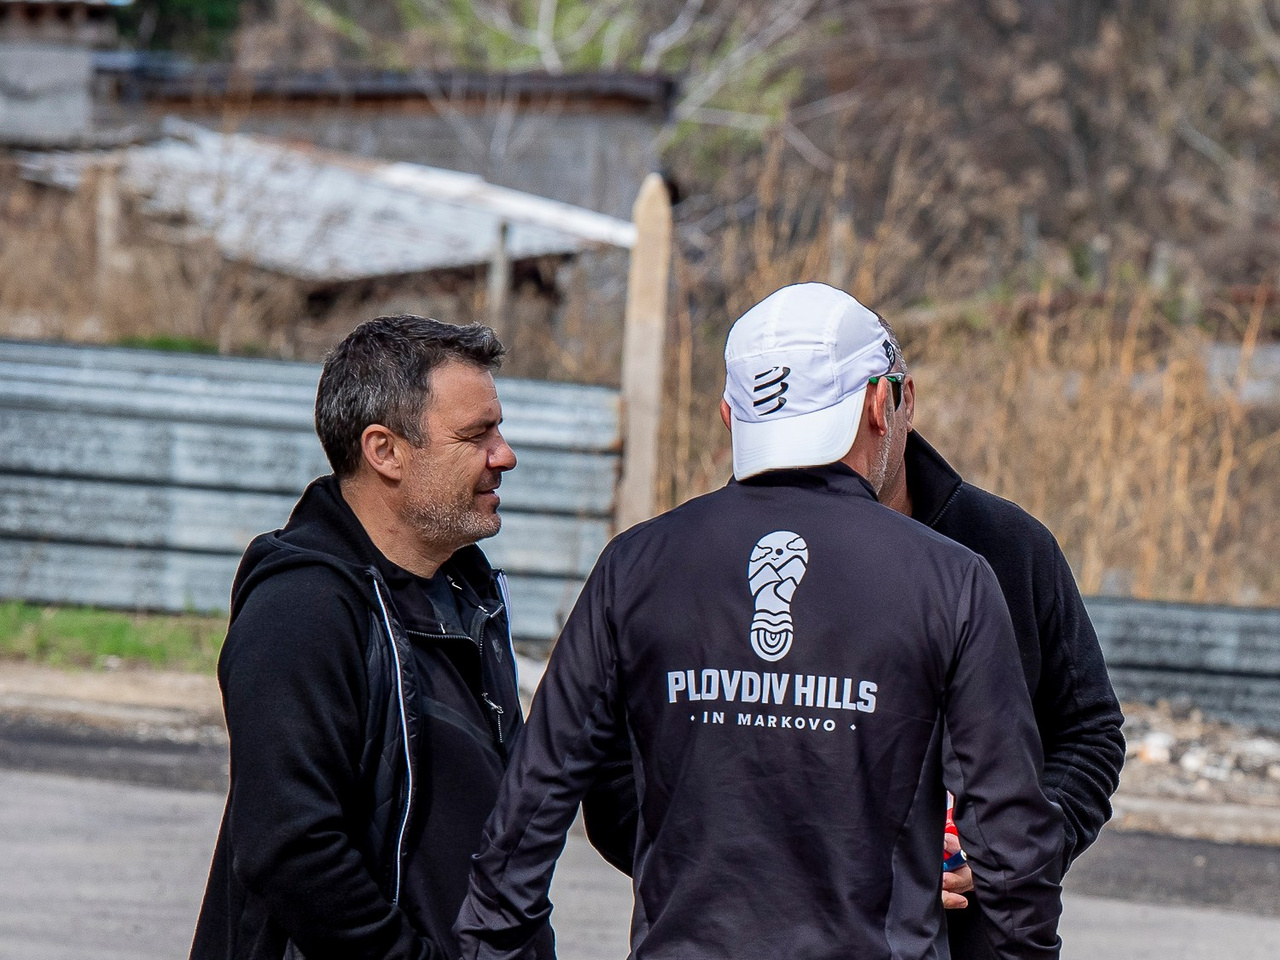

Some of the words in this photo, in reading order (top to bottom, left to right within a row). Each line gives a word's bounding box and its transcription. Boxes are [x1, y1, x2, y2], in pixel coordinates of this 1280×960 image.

[667, 668, 790, 704] PLOVDIV
[794, 673, 878, 713] HILLS
[703, 711, 725, 724] IN
[737, 713, 836, 732] MARKOVO
